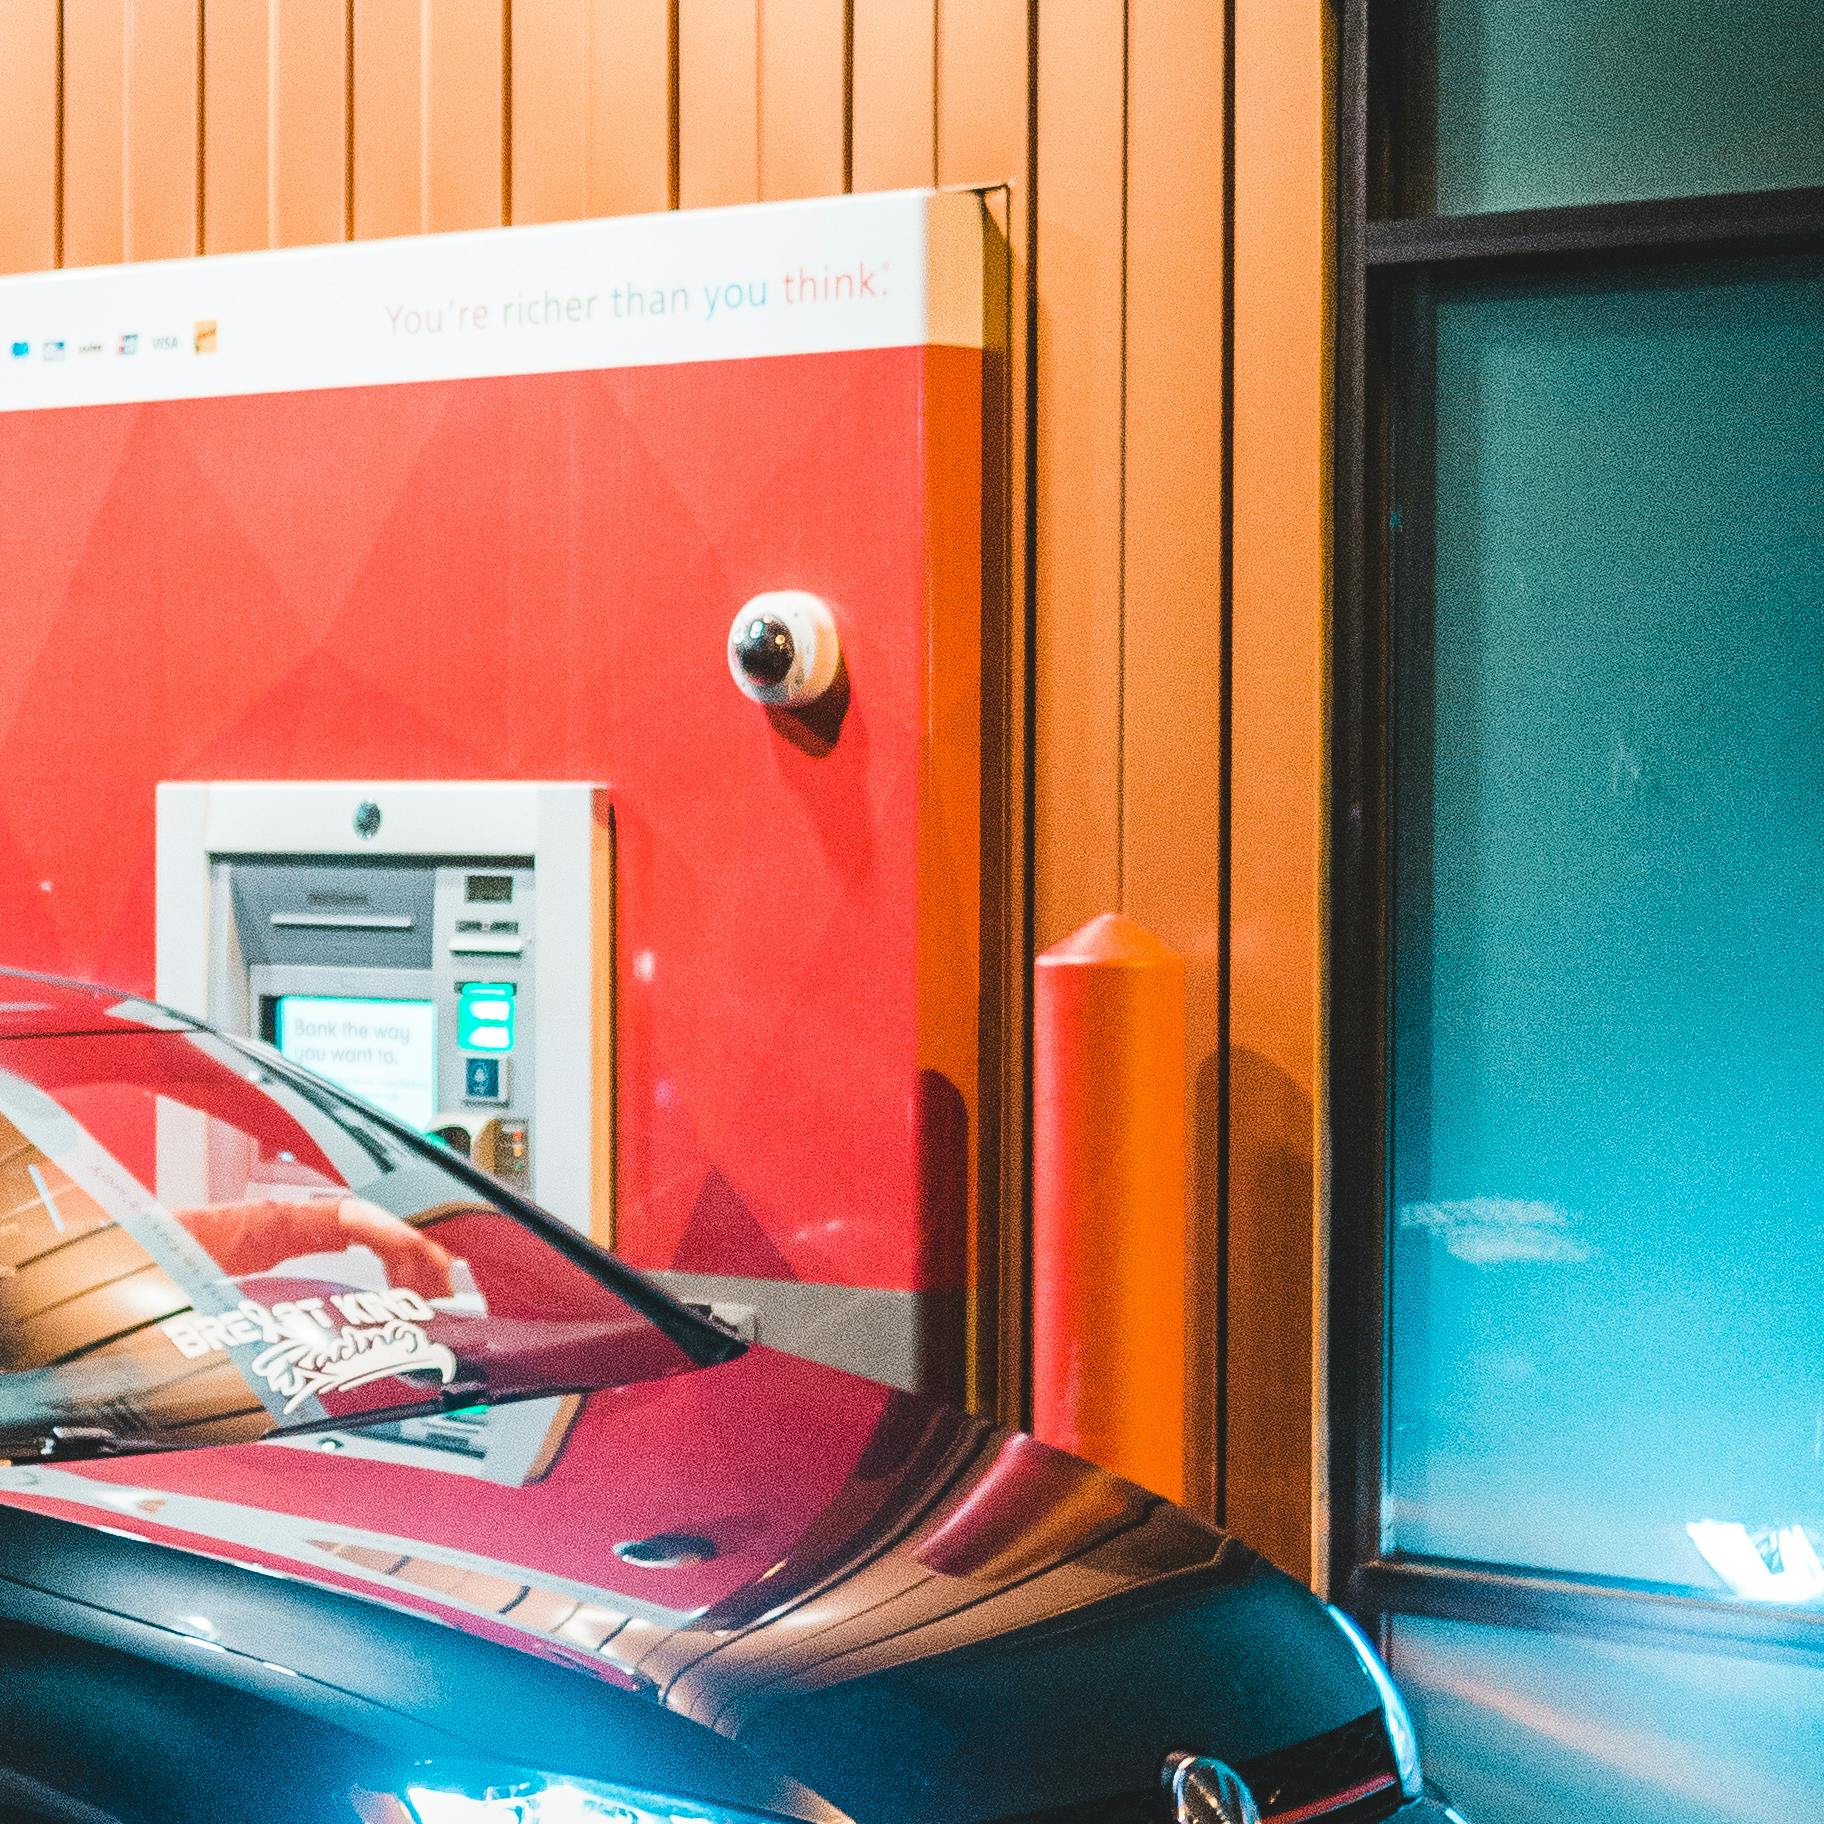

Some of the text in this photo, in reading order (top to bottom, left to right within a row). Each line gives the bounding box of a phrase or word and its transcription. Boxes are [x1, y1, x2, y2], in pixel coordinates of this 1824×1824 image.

[384, 301, 490, 337] You're
[501, 290, 599, 327] richer
[610, 280, 690, 320] than
[702, 277, 768, 321] you
[294, 1018, 411, 1046] Bank the way
[295, 1048, 327, 1064] you
[332, 1048, 374, 1064] want
